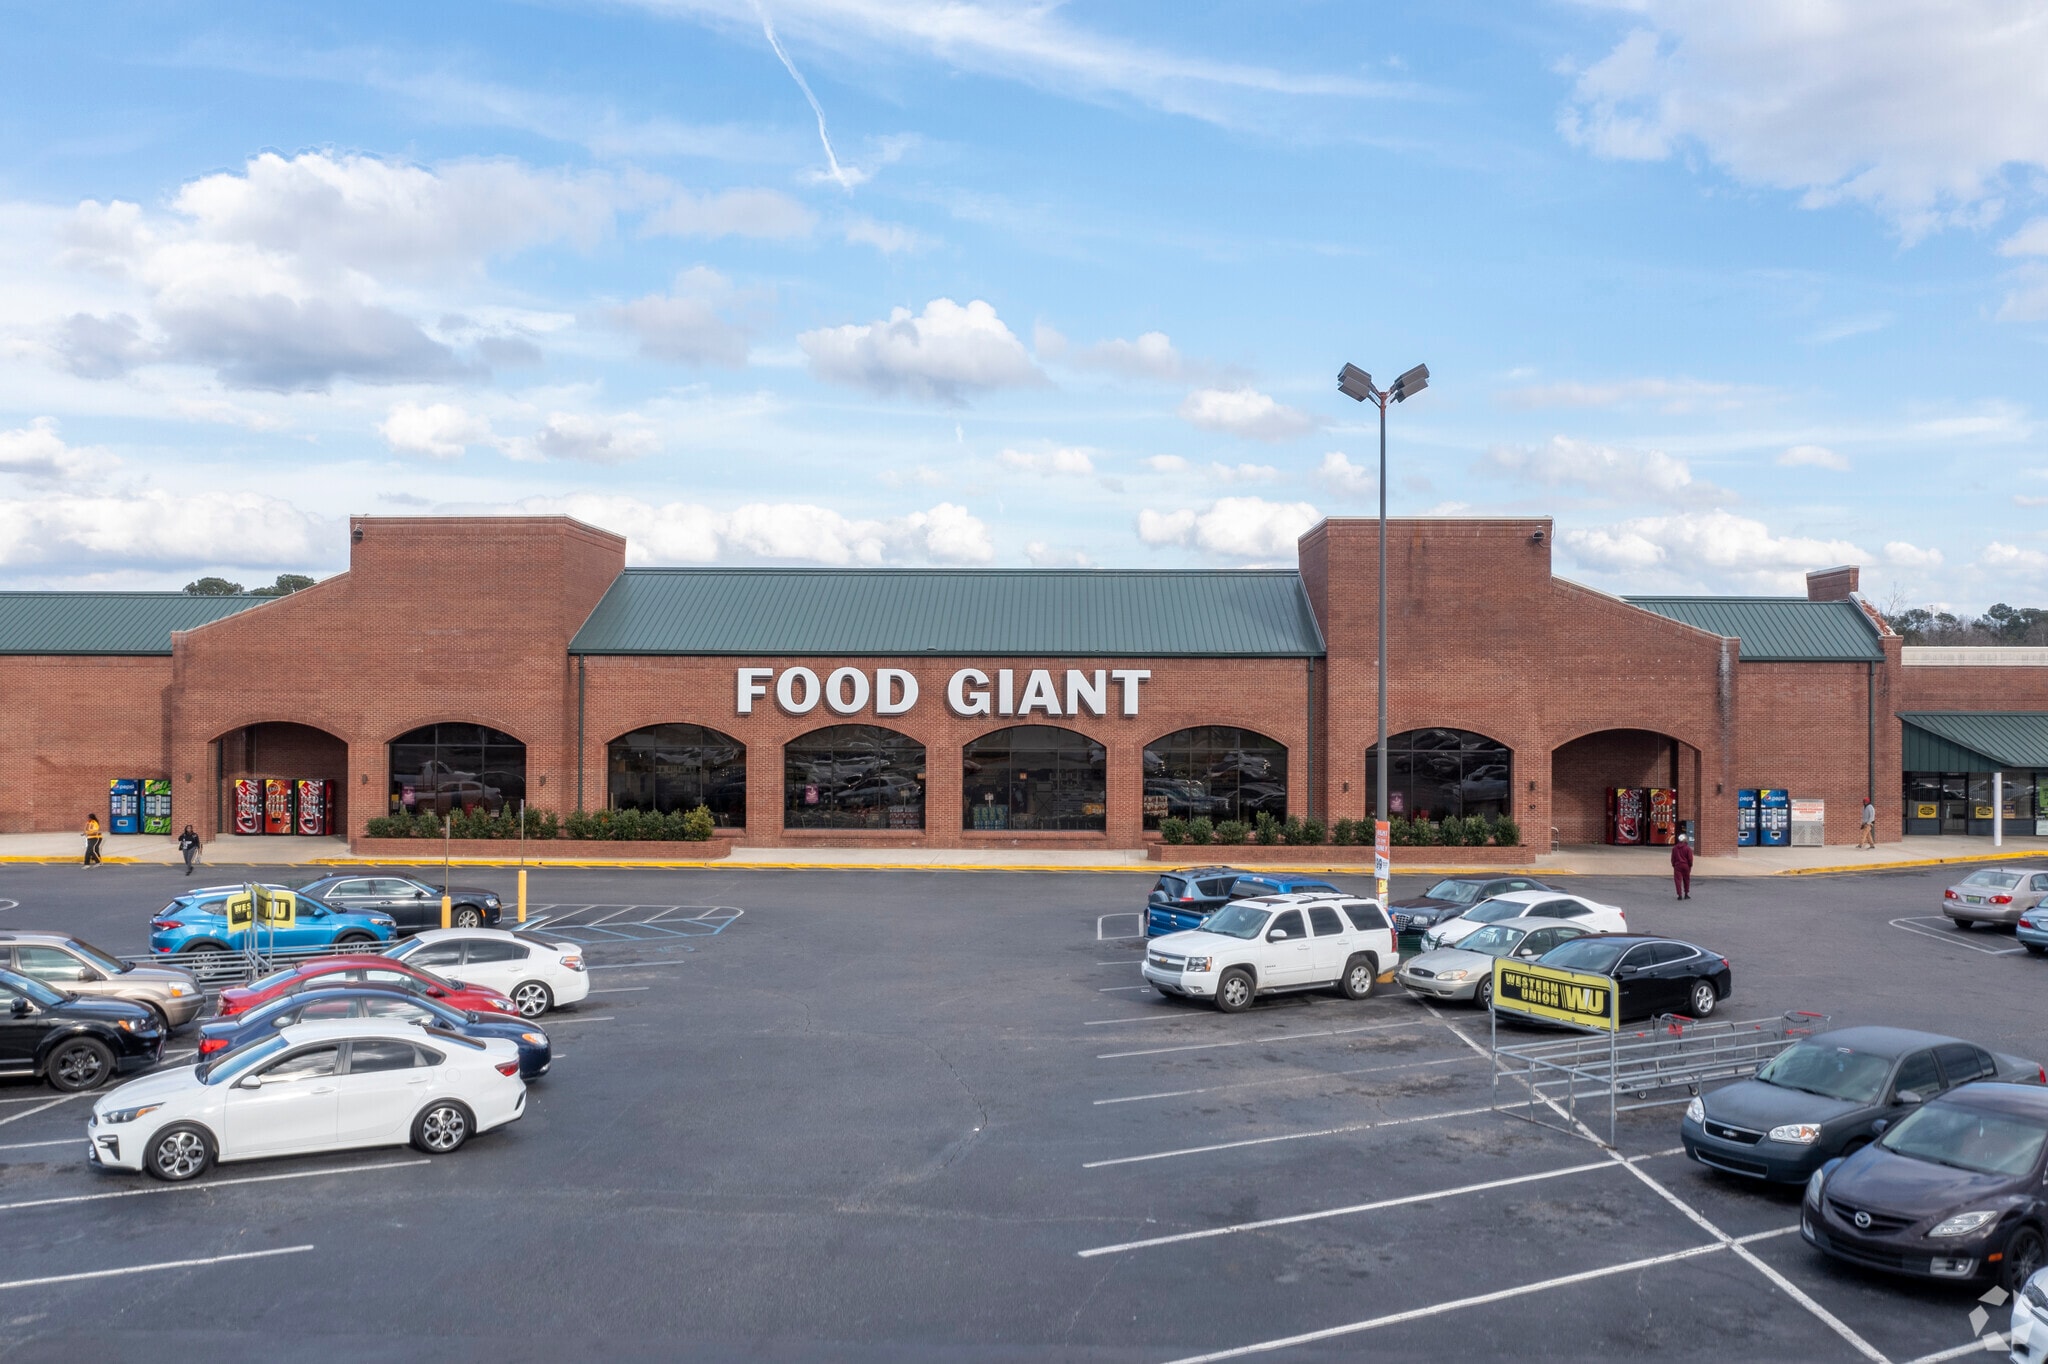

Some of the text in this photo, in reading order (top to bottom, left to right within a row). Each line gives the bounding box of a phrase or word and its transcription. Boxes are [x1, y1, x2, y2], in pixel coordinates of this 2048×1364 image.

[737, 667, 1152, 717] FOOD GIANT
[1505, 972, 1559, 995] WESTERN
[1521, 988, 1559, 1006] UNION
[1564, 985, 1604, 1015] WU
